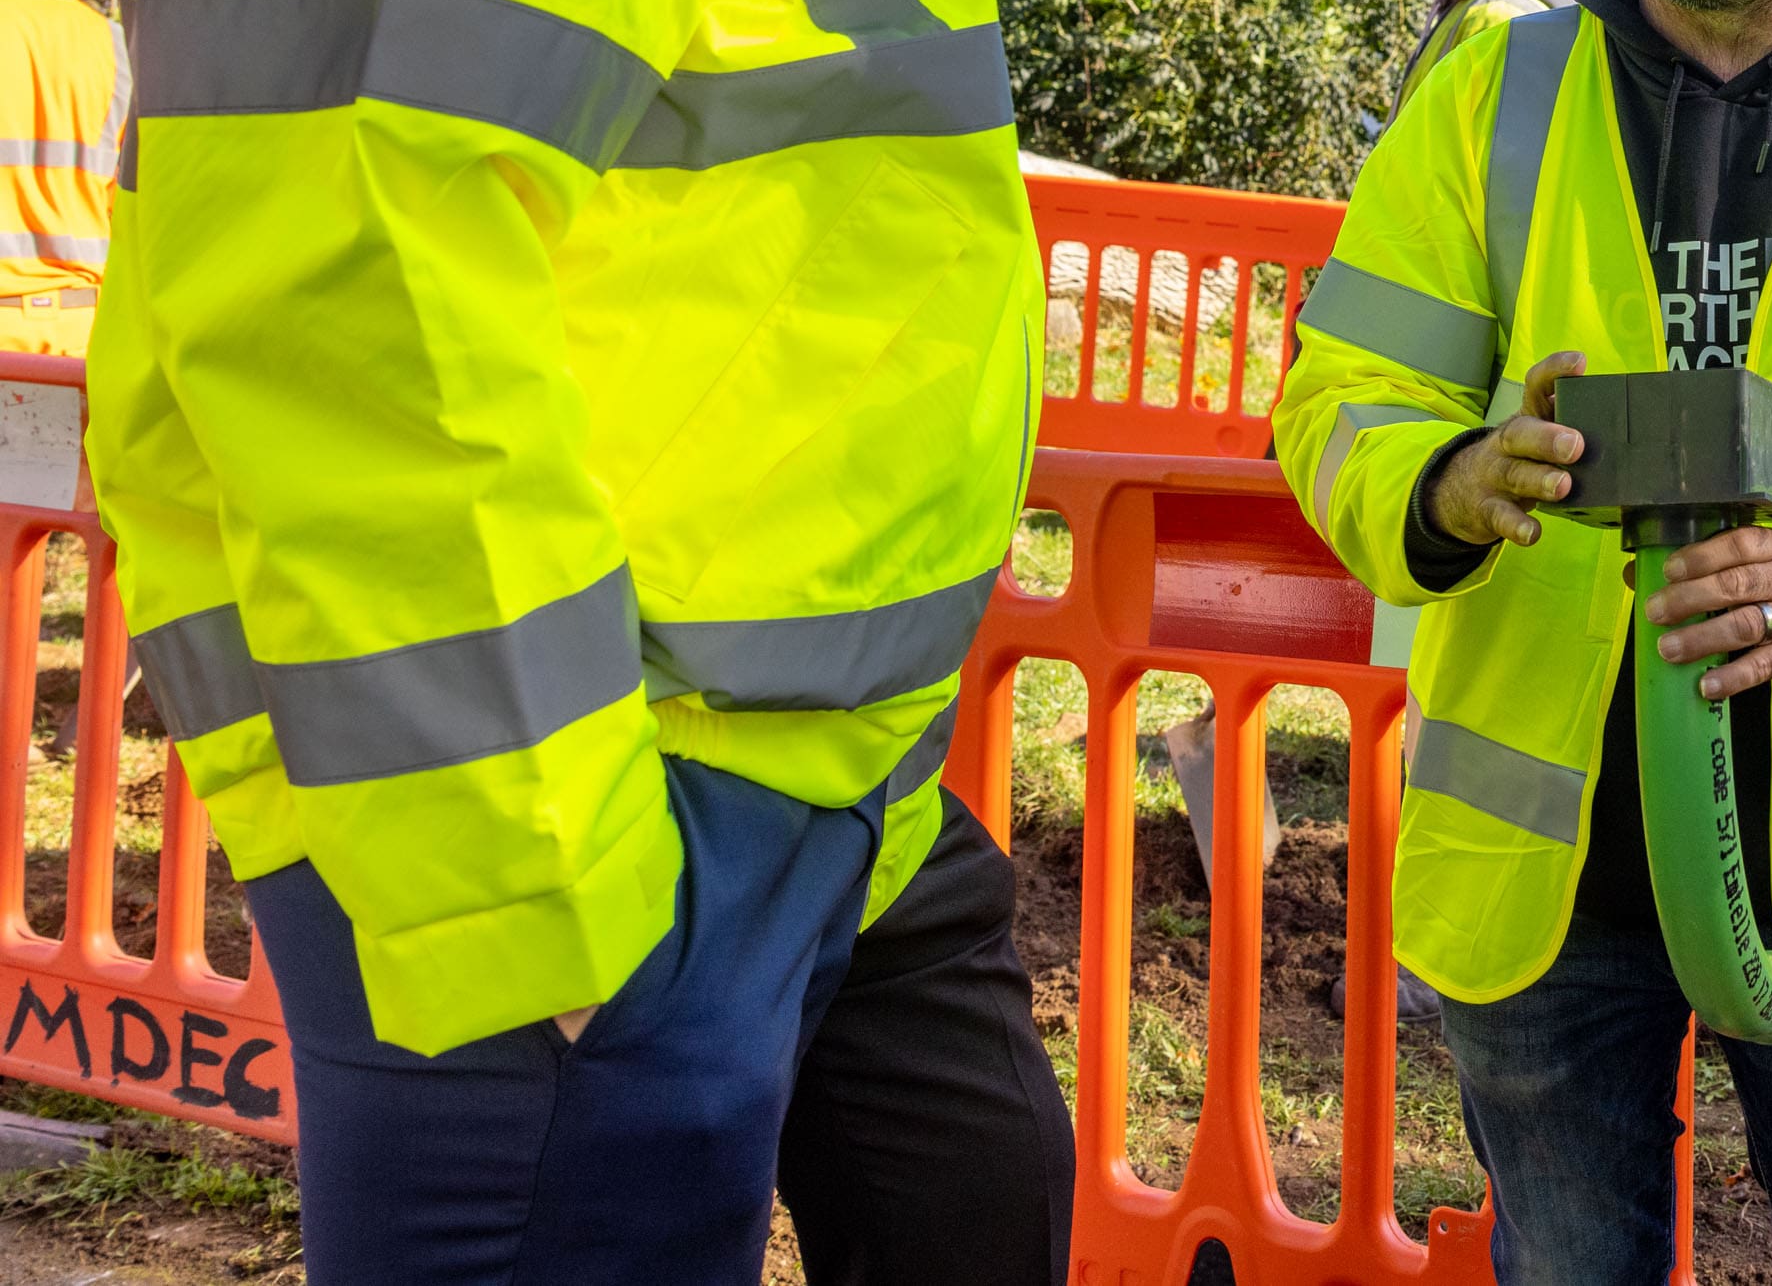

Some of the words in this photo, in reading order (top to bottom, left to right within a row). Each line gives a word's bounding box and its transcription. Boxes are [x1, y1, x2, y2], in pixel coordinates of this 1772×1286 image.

[1667, 238, 1759, 291] THE
[1709, 739, 1729, 804] code
[1716, 810, 1738, 861] 571
